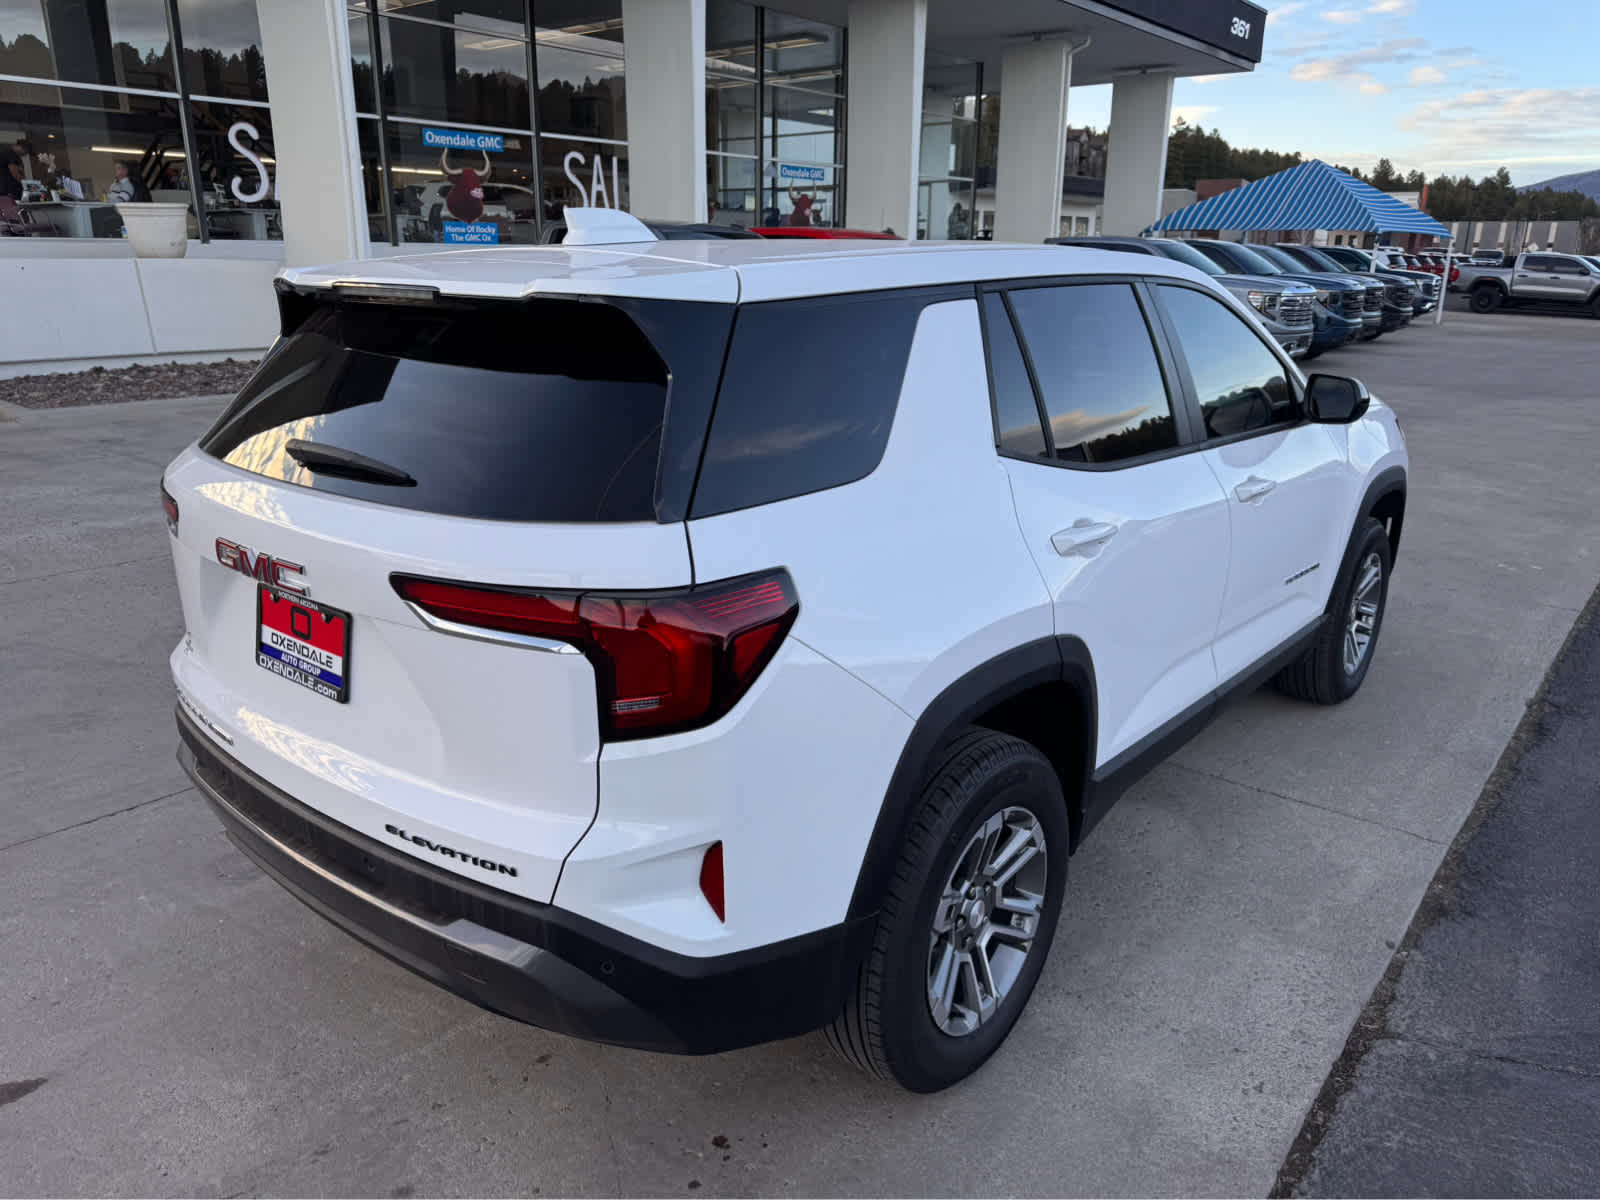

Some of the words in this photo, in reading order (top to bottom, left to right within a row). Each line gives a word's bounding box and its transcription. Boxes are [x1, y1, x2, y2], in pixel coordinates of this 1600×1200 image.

[1231, 17, 1250, 39] 361
[425, 131, 475, 147] Oxendale
[477, 135, 502, 149] GMC
[216, 537, 311, 598] GMC
[271, 632, 333, 669] OXENDALE
[281, 651, 298, 667] AUTO
[298, 661, 321, 676] GROUP
[259, 656, 338, 700] OXENDALE.com
[385, 823, 518, 877] ELEVATION
